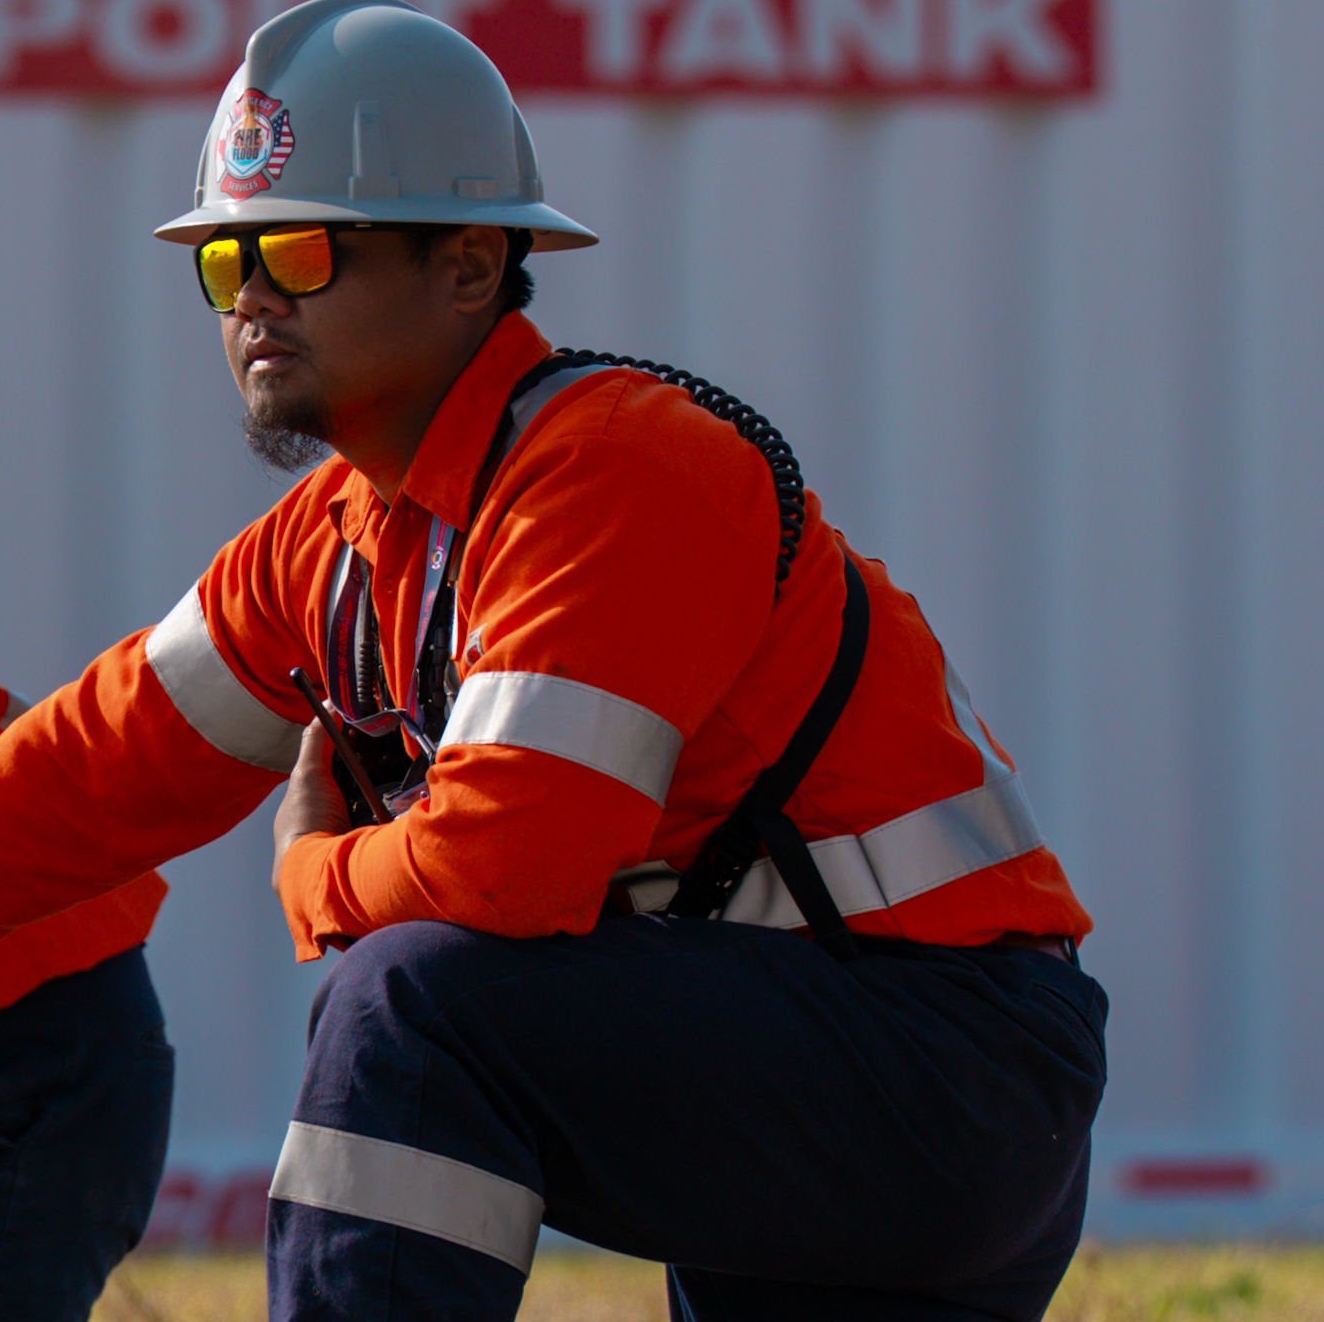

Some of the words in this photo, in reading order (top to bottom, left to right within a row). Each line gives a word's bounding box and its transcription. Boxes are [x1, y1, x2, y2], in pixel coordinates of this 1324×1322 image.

[235, 96, 273, 112] RGENCY
[235, 128, 261, 146] FIRE
[232, 147, 259, 160] FLOOD
[227, 180, 258, 192] SERVICES
